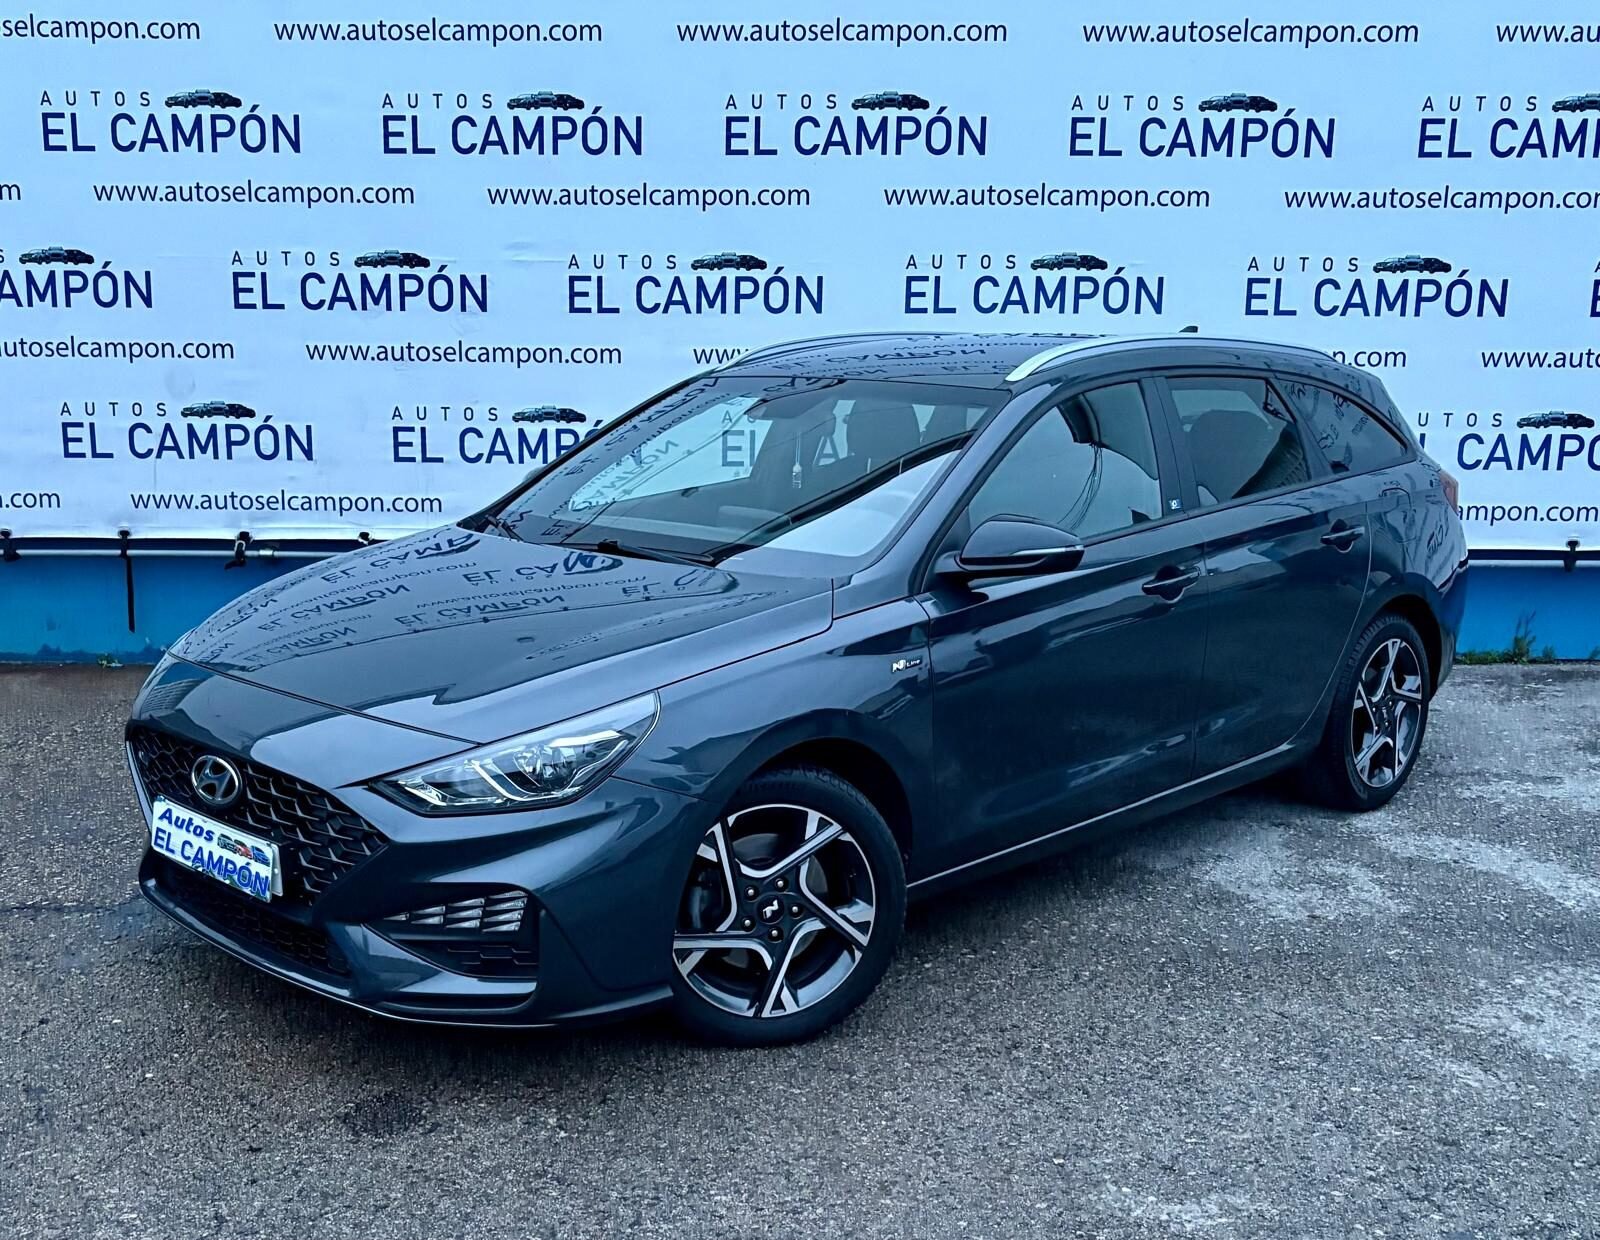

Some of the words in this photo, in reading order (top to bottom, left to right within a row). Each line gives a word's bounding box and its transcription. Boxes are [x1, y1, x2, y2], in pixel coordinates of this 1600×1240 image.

[274, 17, 601, 47] www.autoselcampon.com
[677, 17, 1006, 47] www.autoselcampon.com
[1083, 18, 1418, 48] www.autoselcampon.com
[40, 91, 150, 107] AUTOS
[382, 93, 492, 109] AUTOS
[726, 94, 836, 109] AUTOS
[1072, 95, 1183, 111] AUTOS
[1422, 96, 1536, 111] AUTOS
[42, 112, 96, 152] EL
[111, 105, 300, 153] CAMPÓN
[383, 115, 435, 154] EL
[452, 106, 642, 155] CAMPÓN
[725, 116, 777, 155] EL
[795, 107, 987, 155] CAMPÓN
[1070, 117, 1122, 156] EL
[1140, 108, 1335, 158] CAMPÓN
[1418, 118, 1472, 158] EL
[93, 180, 414, 208] www.autoselcampon.com
[487, 183, 809, 211] www.autoselcampon.com
[884, 183, 1209, 212] www.autoselcampon.com
[232, 251, 339, 266] AUTOS
[568, 254, 676, 269] AUTOS
[906, 254, 1015, 269] AUTOS
[1248, 257, 1358, 272] AUTOS
[233, 272, 285, 309] EL
[301, 265, 487, 312] CAMPÓN
[569, 276, 620, 313] EL
[636, 266, 823, 314] CAMPÓN
[905, 276, 956, 314] EL
[974, 267, 1164, 314] CAMPÓN
[1245, 278, 1297, 316] EL
[1314, 269, 1508, 317] CAMPÓN
[0, 336, 234, 363] utoselcampon.com
[306, 340, 621, 368] www.autoselcampon.com
[61, 402, 166, 417] AUTOS
[392, 406, 497, 421] AUTOS
[62, 422, 114, 458] EL
[129, 415, 313, 461] CAMPÓN
[393, 426, 444, 463] EL
[0, 493, 60, 508] .com
[131, 489, 442, 516] www.autoselcampon.com
[158, 808, 214, 842] Autos
[153, 826, 176, 854] EL
[180, 840, 269, 897] CAMPÓN
